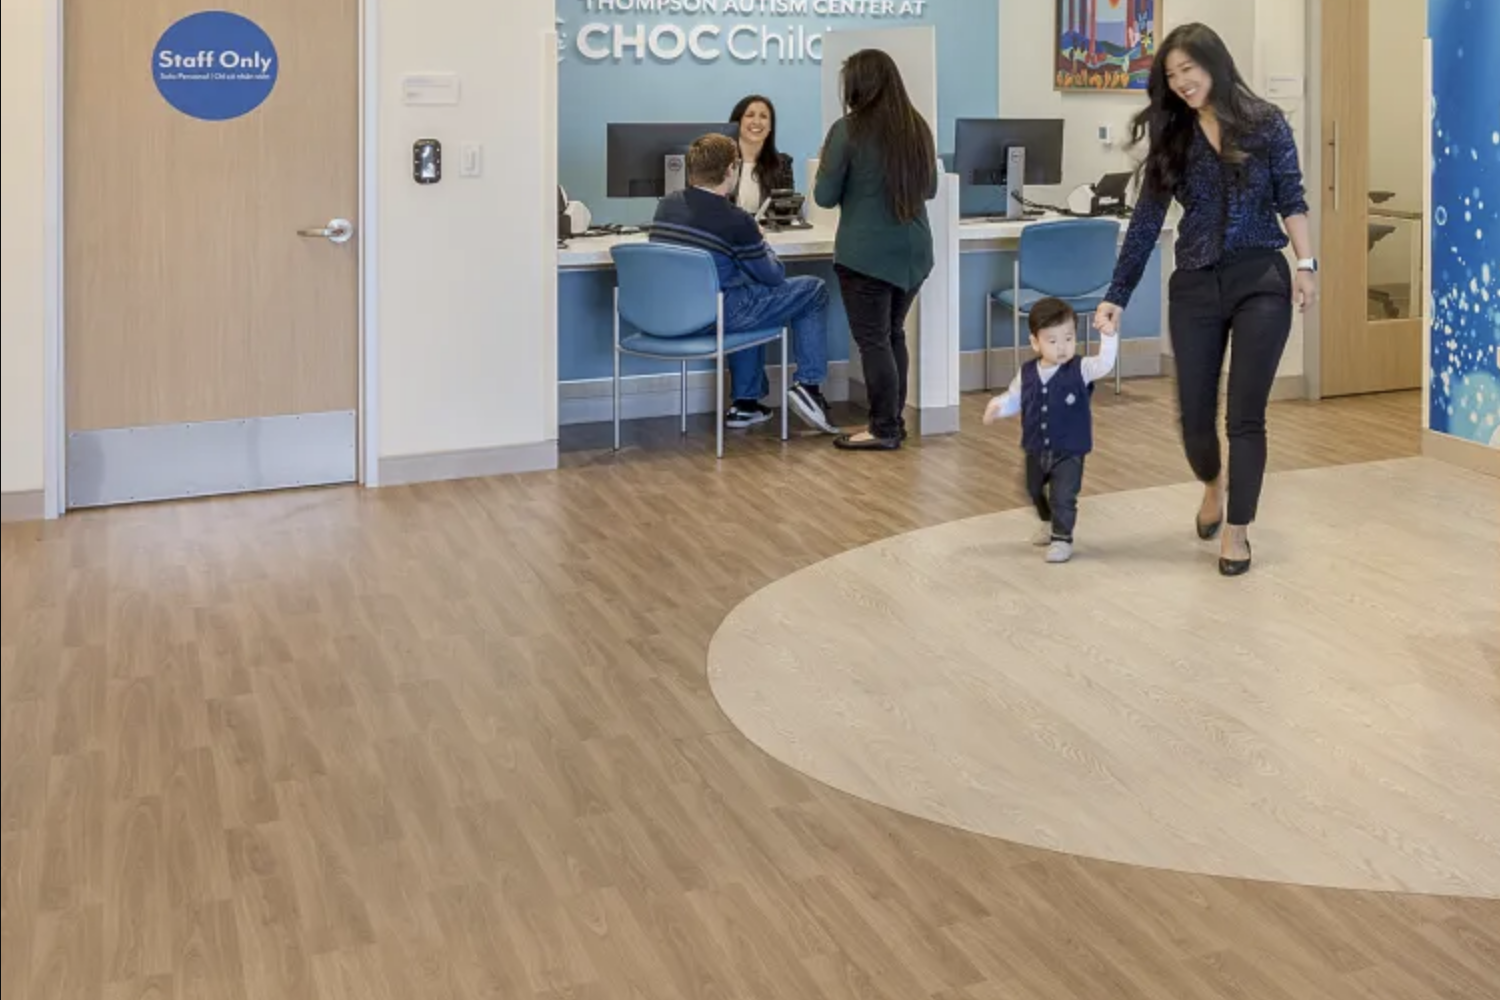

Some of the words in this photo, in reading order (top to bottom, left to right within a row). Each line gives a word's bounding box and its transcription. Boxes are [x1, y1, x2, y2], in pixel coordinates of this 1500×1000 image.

[899, 0, 926, 16] AT
[576, 22, 721, 60] CHOC
[159, 50, 214, 68] Staff
[219, 50, 272, 73] Only
